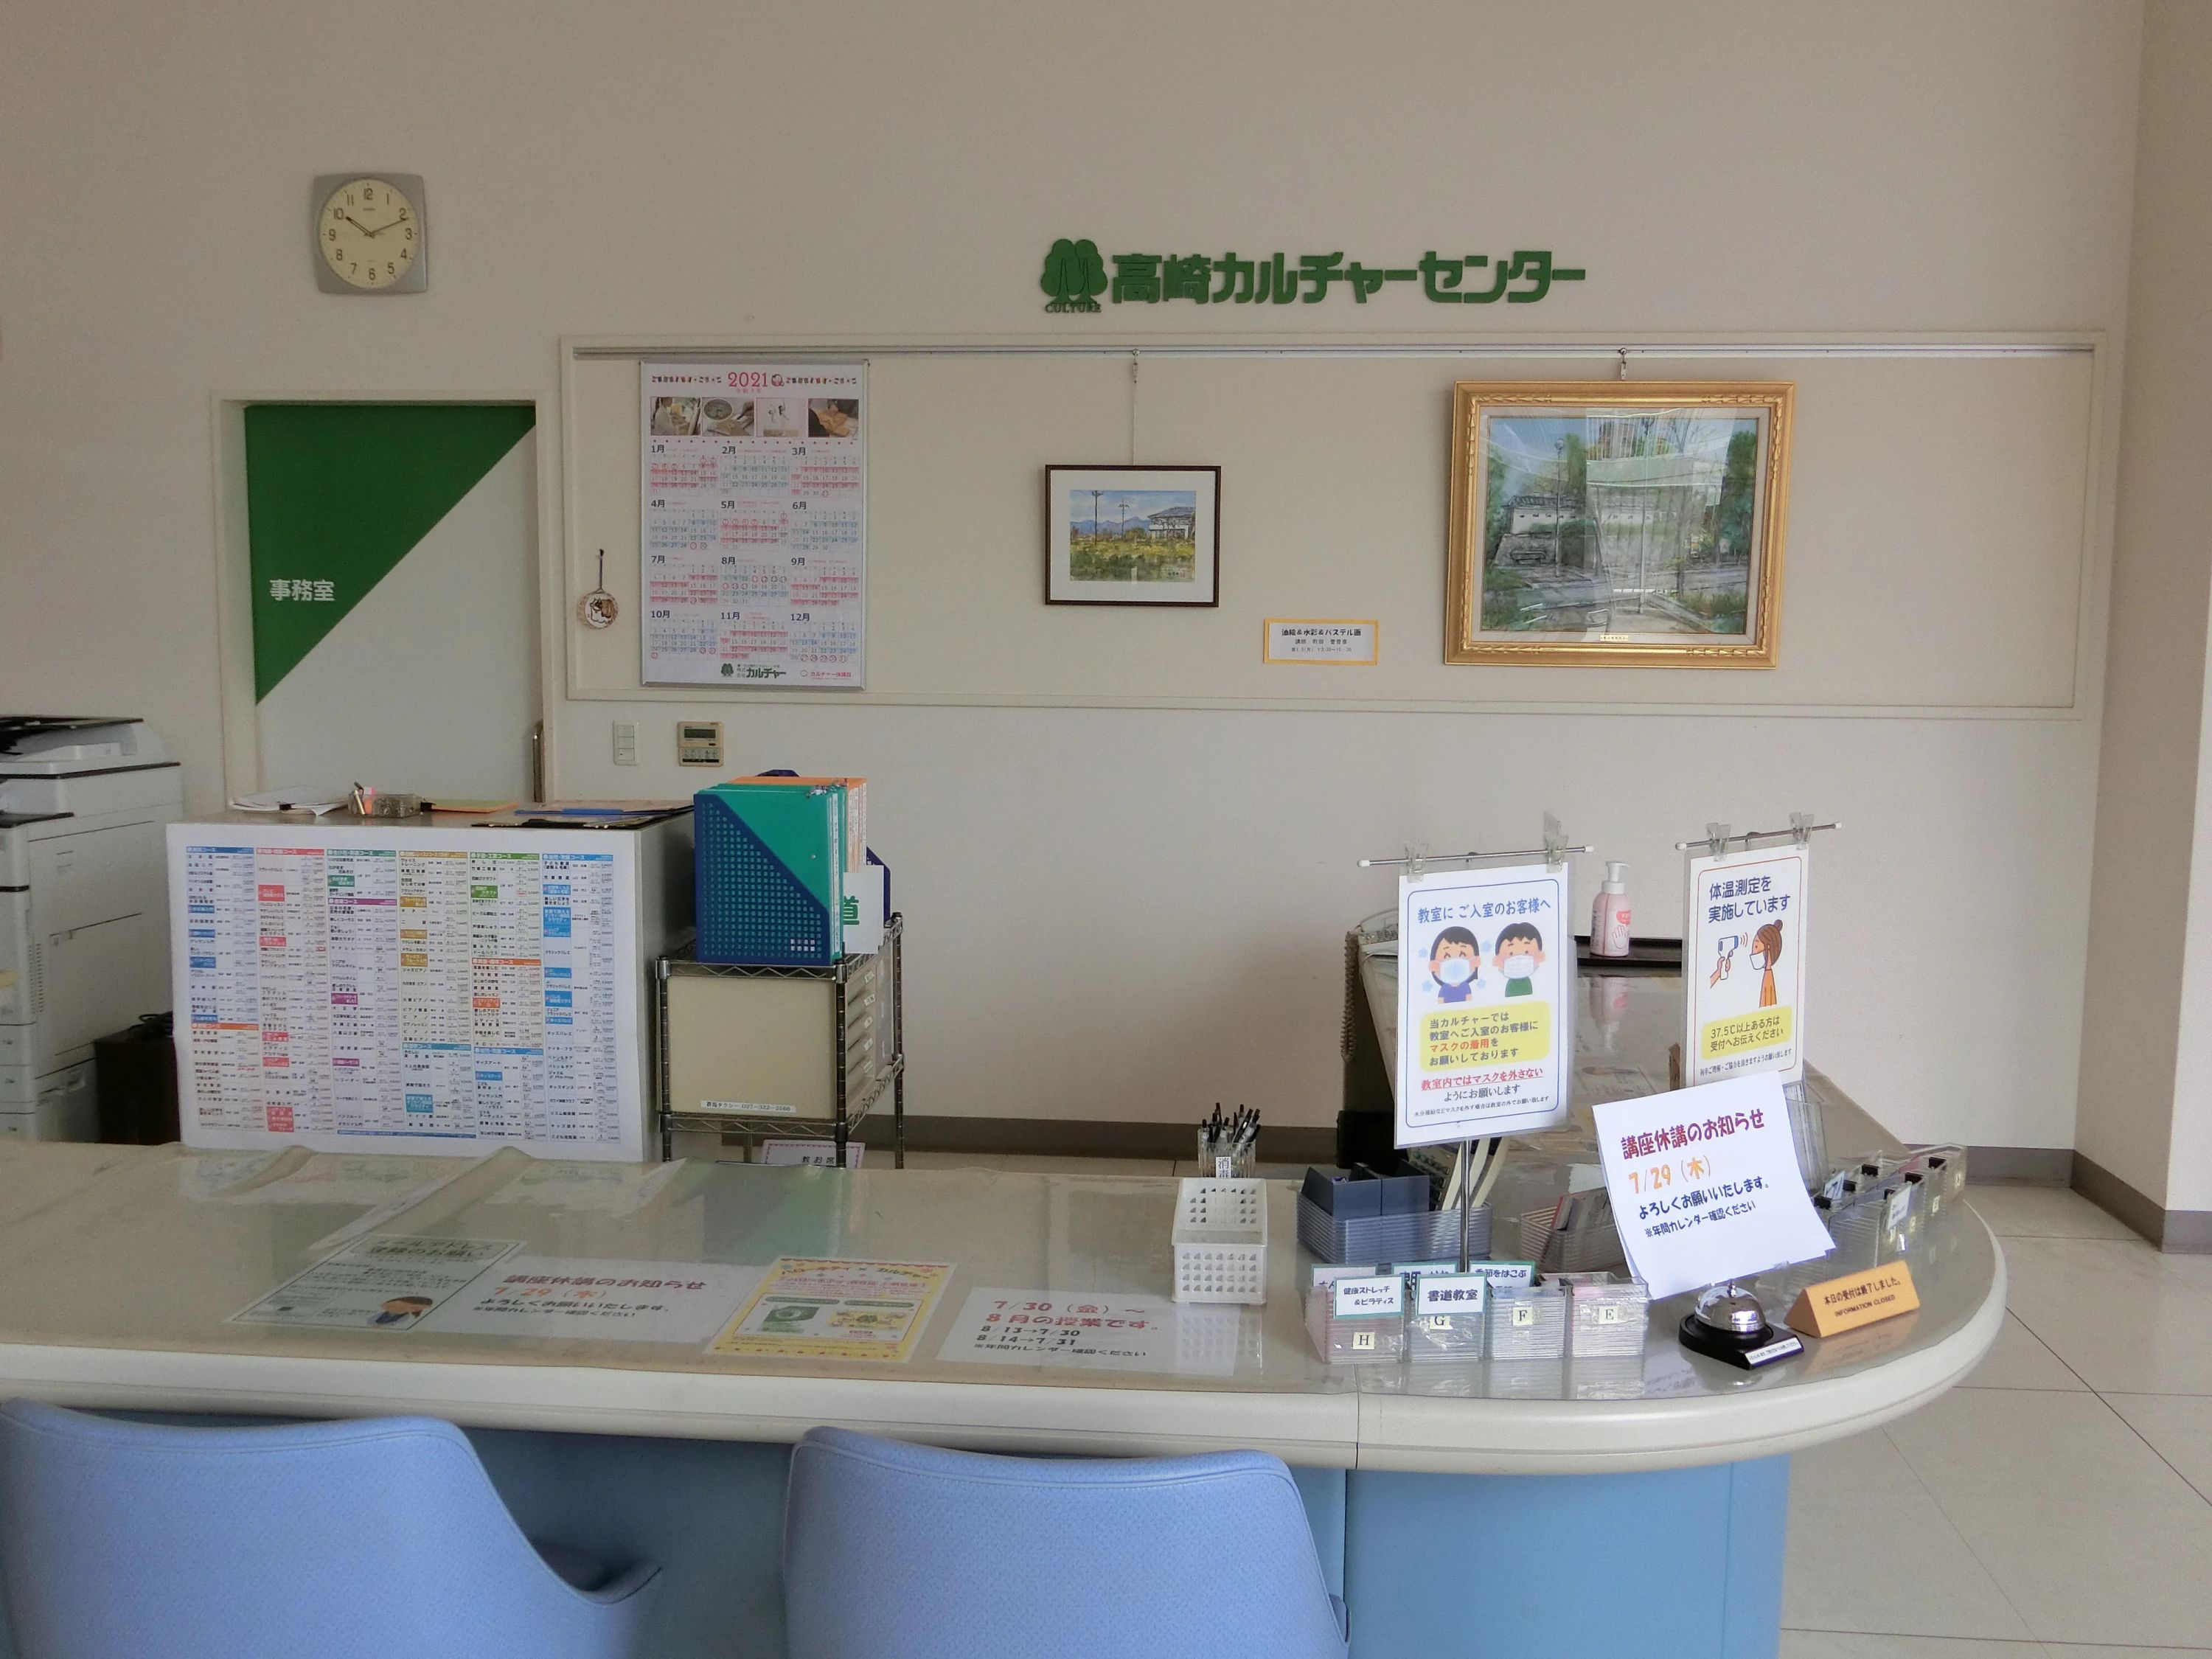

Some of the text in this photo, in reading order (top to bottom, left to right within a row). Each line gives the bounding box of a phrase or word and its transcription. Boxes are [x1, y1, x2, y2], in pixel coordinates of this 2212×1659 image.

[347, 195, 354, 206] 11
[364, 188, 374, 201] 12
[386, 193, 389, 206] 1
[333, 208, 344, 220] 10
[399, 208, 408, 220] 2
[329, 229, 336, 241] 9
[405, 228, 412, 240] 3
[336, 249, 343, 260] 8
[400, 248, 407, 259] 4
[350, 262, 358, 274] 7
[369, 268, 376, 280] 6
[387, 262, 394, 274] 5
[1112, 251, 1586, 305] 高崎カルチャーセンター
[1044, 302, 1102, 313] CULTURE
[728, 372, 768, 387] 2021
[651, 445, 664, 453] 1月
[721, 445, 736, 455] 2月
[792, 447, 806, 456] 3月
[651, 499, 665, 508] 4月
[721, 500, 735, 509] 5月
[793, 501, 807, 510] 6月
[651, 554, 665, 564] 7月
[721, 556, 736, 566] 8月
[790, 557, 805, 566] 9月
[269, 578, 335, 602] 事務室
[651, 610, 670, 619] 10月
[720, 611, 740, 620] 11月
[790, 613, 810, 622] 12月
[745, 667, 787, 678] カルチャー
[1709, 875, 1772, 901] 体温測定を
[1708, 894, 1791, 923] 実施しています
[1430, 1012, 1509, 1029] 当カルチャーでは
[1430, 1021, 1539, 1041] 教室へご入室のお客様に
[1711, 1015, 1780, 1039] 37.5℃以上ある方は
[1430, 1037, 1498, 1053] マスクの着用を
[1710, 1028, 1784, 1052] 受付へお伝えください
[1430, 1048, 1519, 1066] お願いしております
[1421, 1068, 1543, 1090] 教室内ではマスクを外さない
[1444, 1084, 1520, 1102] ようにお願いします
[1621, 1108, 1764, 1160] 講座休講のお知らせ
[1639, 1176, 1770, 1220] よろしくお願いいたします。
[1644, 1200, 1756, 1238] ※年間カレンダー確認ください
[503, 1275, 706, 1290] 講座休講のお知らせ
[1343, 1285, 1390, 1295] 健康ストレッチ
[1427, 1290, 1478, 1302] 書道教室
[1824, 1277, 1900, 1306] 本日の受付は終了しました。
[481, 1298, 669, 1312] よろしくお願いいたします。
[1354, 1297, 1394, 1306] &ピラティス
[1834, 1294, 1896, 1317] INFORMATION CLOSED
[473, 1306, 636, 1317] ※年間カレンダー確認ください
[1518, 1310, 1528, 1321] F
[1604, 1308, 1614, 1321] E
[986, 1314, 1158, 1329] 8月の授業です。
[1434, 1315, 1444, 1326] G
[1358, 1335, 1369, 1346] H
[974, 1343, 1147, 1357] ※年間カレンダー確認ください
